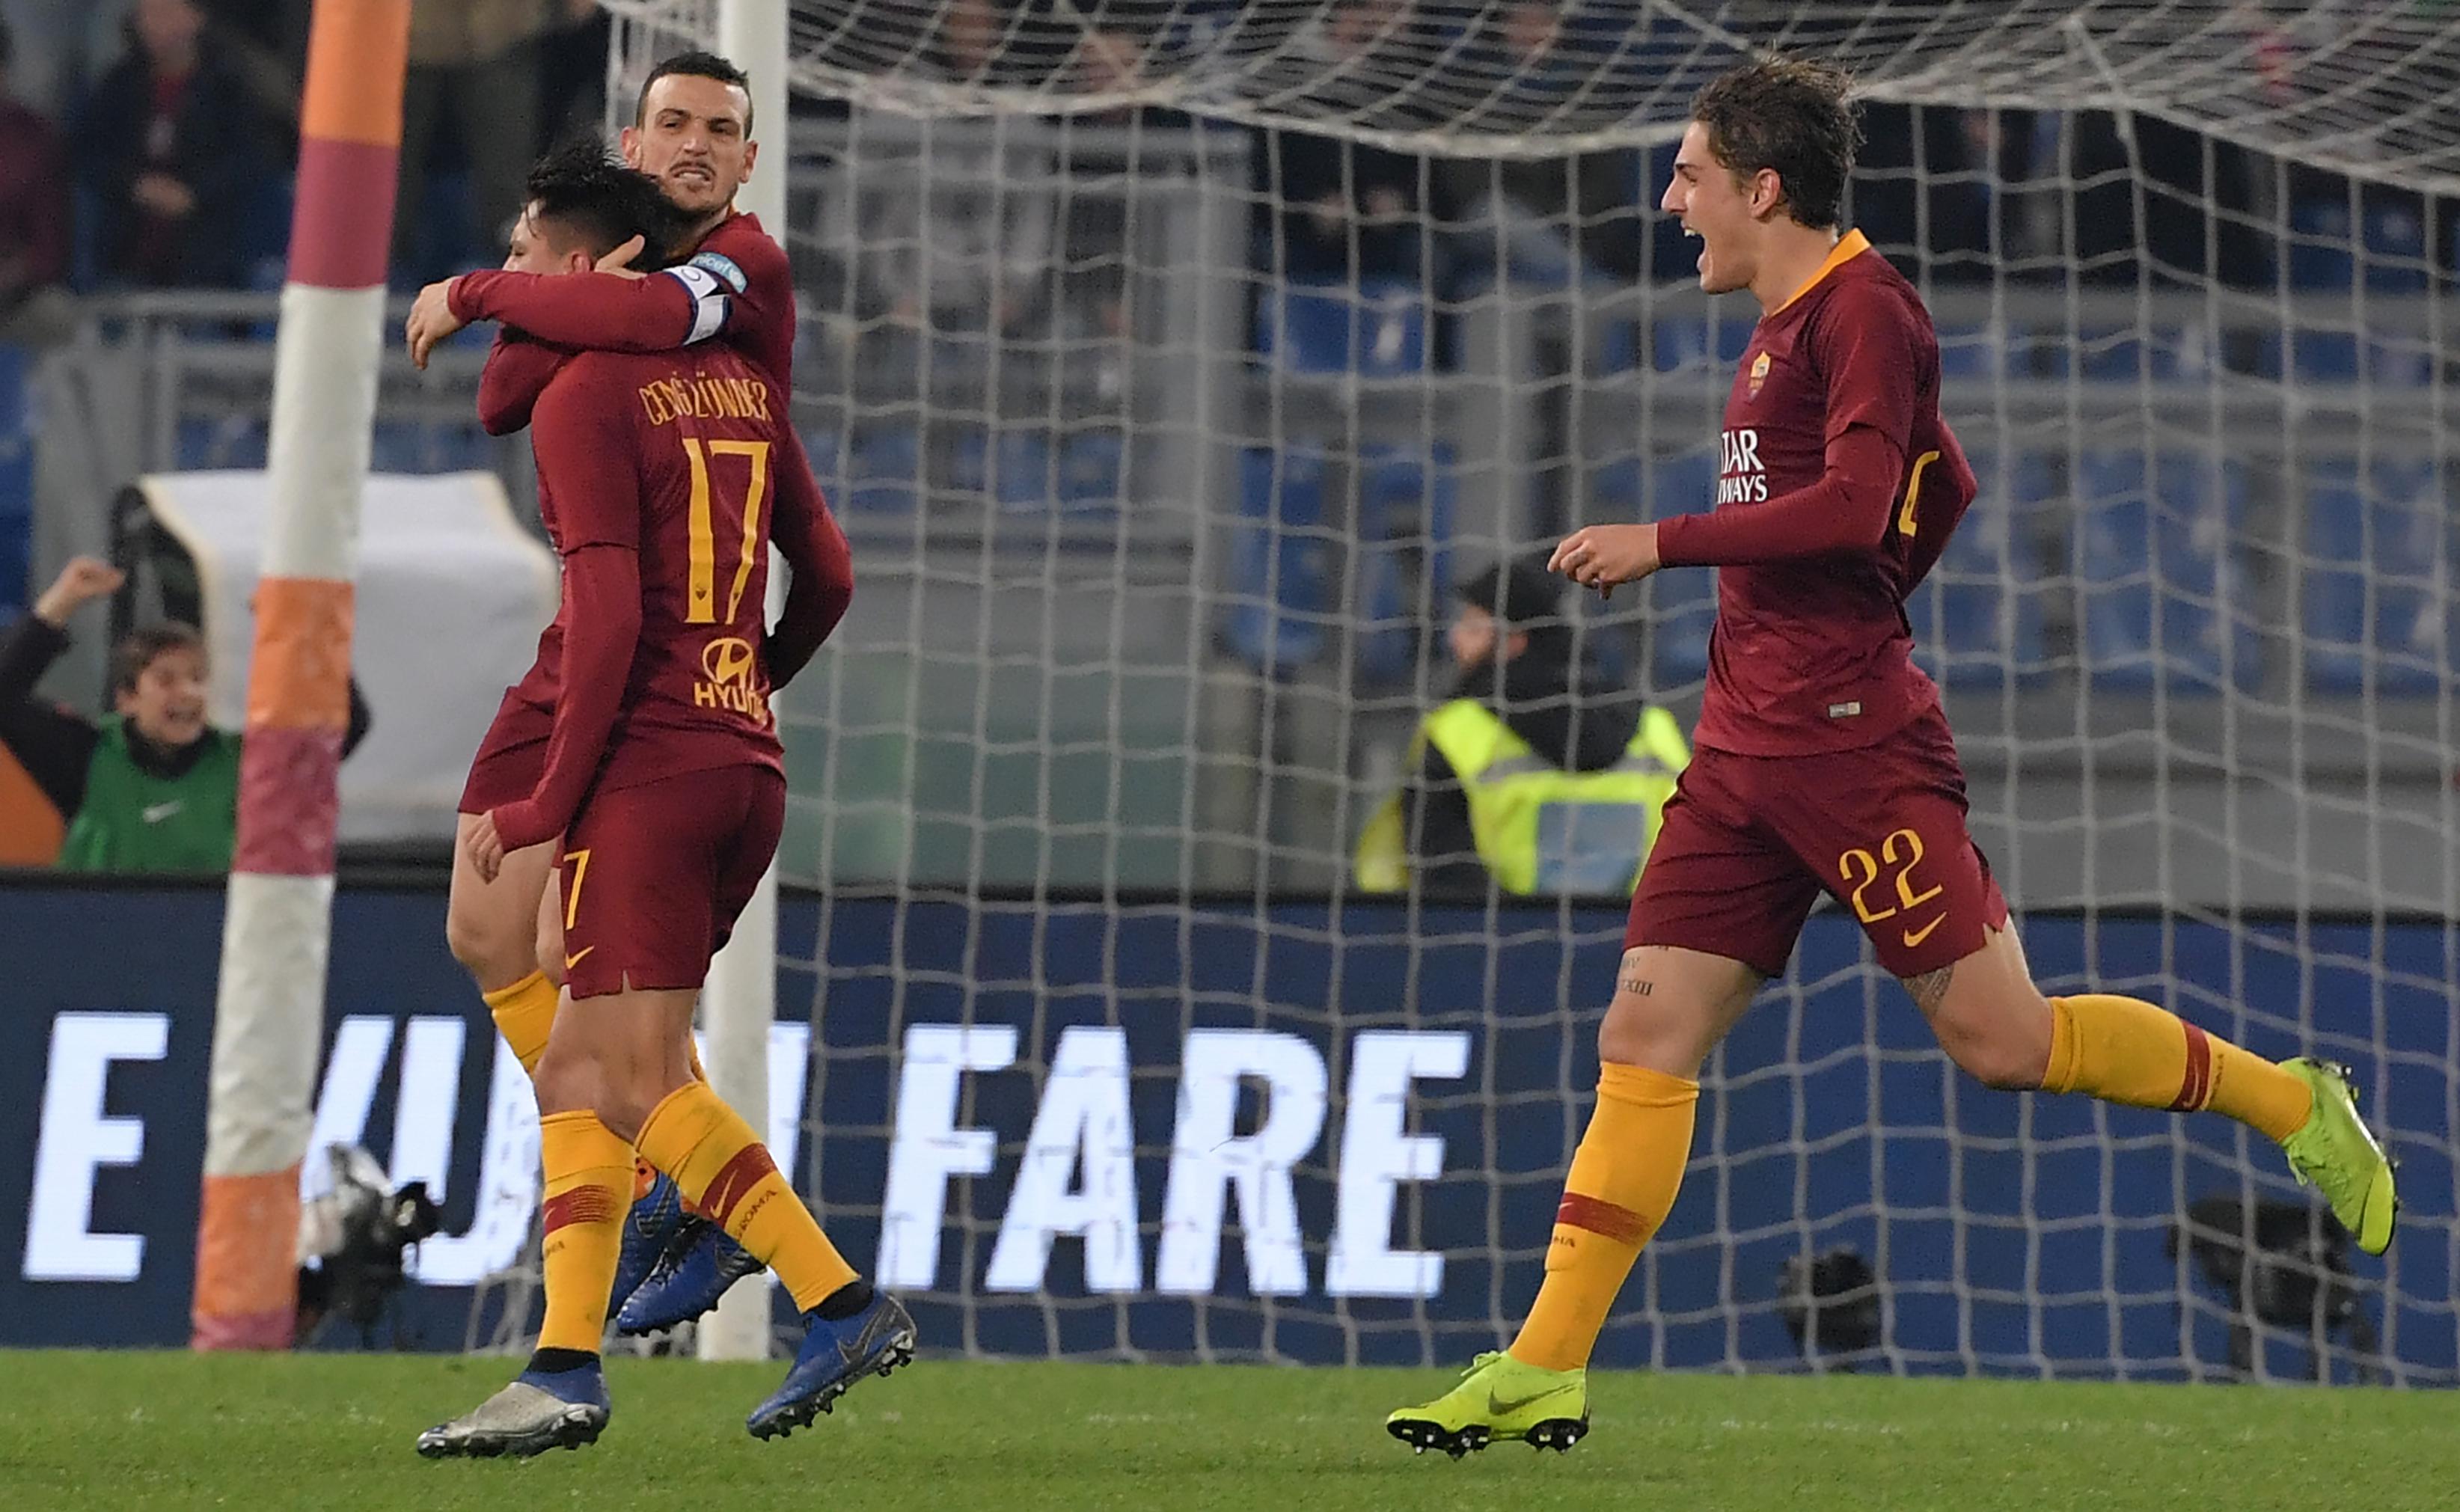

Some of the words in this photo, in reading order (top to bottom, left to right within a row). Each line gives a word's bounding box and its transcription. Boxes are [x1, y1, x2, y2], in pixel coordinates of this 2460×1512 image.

[1721, 429, 1766, 474] TAR
[683, 438, 771, 625] 17
[1838, 828, 1943, 923] 22
[22, 1011, 171, 1282] E
[875, 1023, 1472, 1298] FARE
